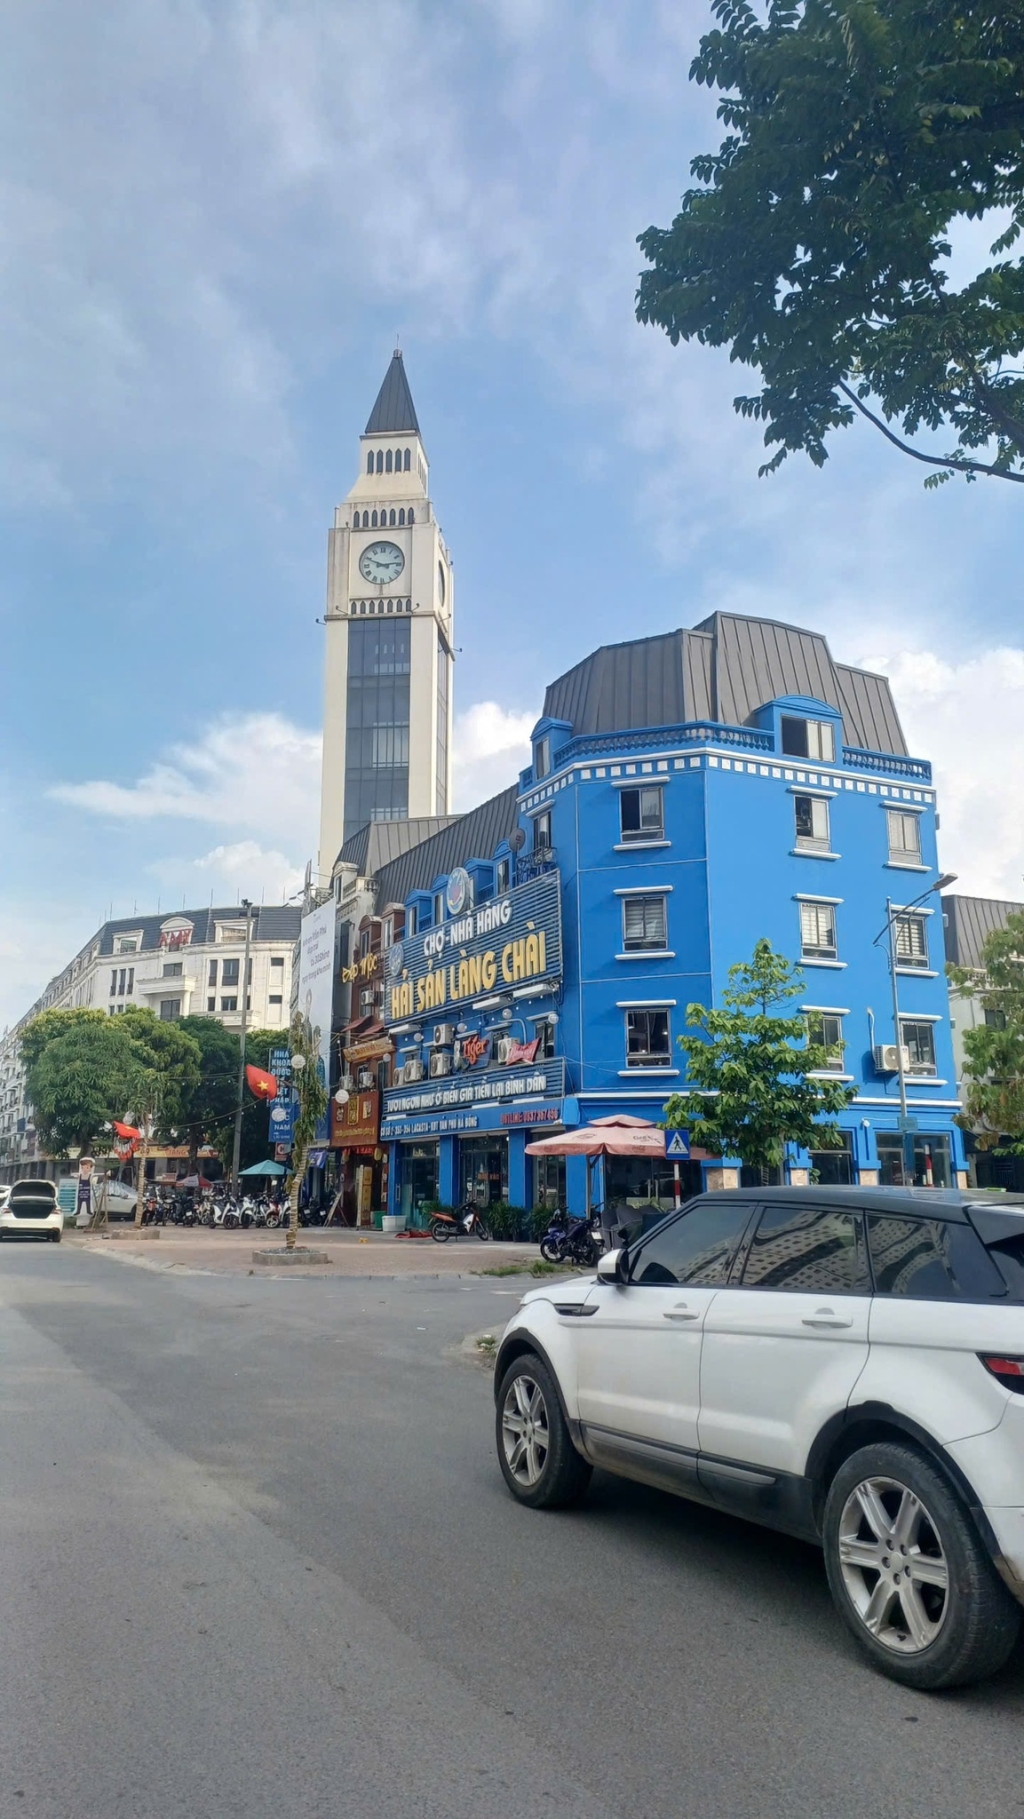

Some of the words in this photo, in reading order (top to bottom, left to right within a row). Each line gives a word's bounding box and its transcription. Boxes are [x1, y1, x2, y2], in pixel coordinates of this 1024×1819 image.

[476, 900, 513, 935] HÀNG
[391, 968, 414, 1020] HẢI
[416, 958, 447, 1013] SẢN
[449, 949, 498, 1001] LÀNG
[501, 921, 547, 983] CHÀI
[462, 1034, 487, 1065] Tiger
